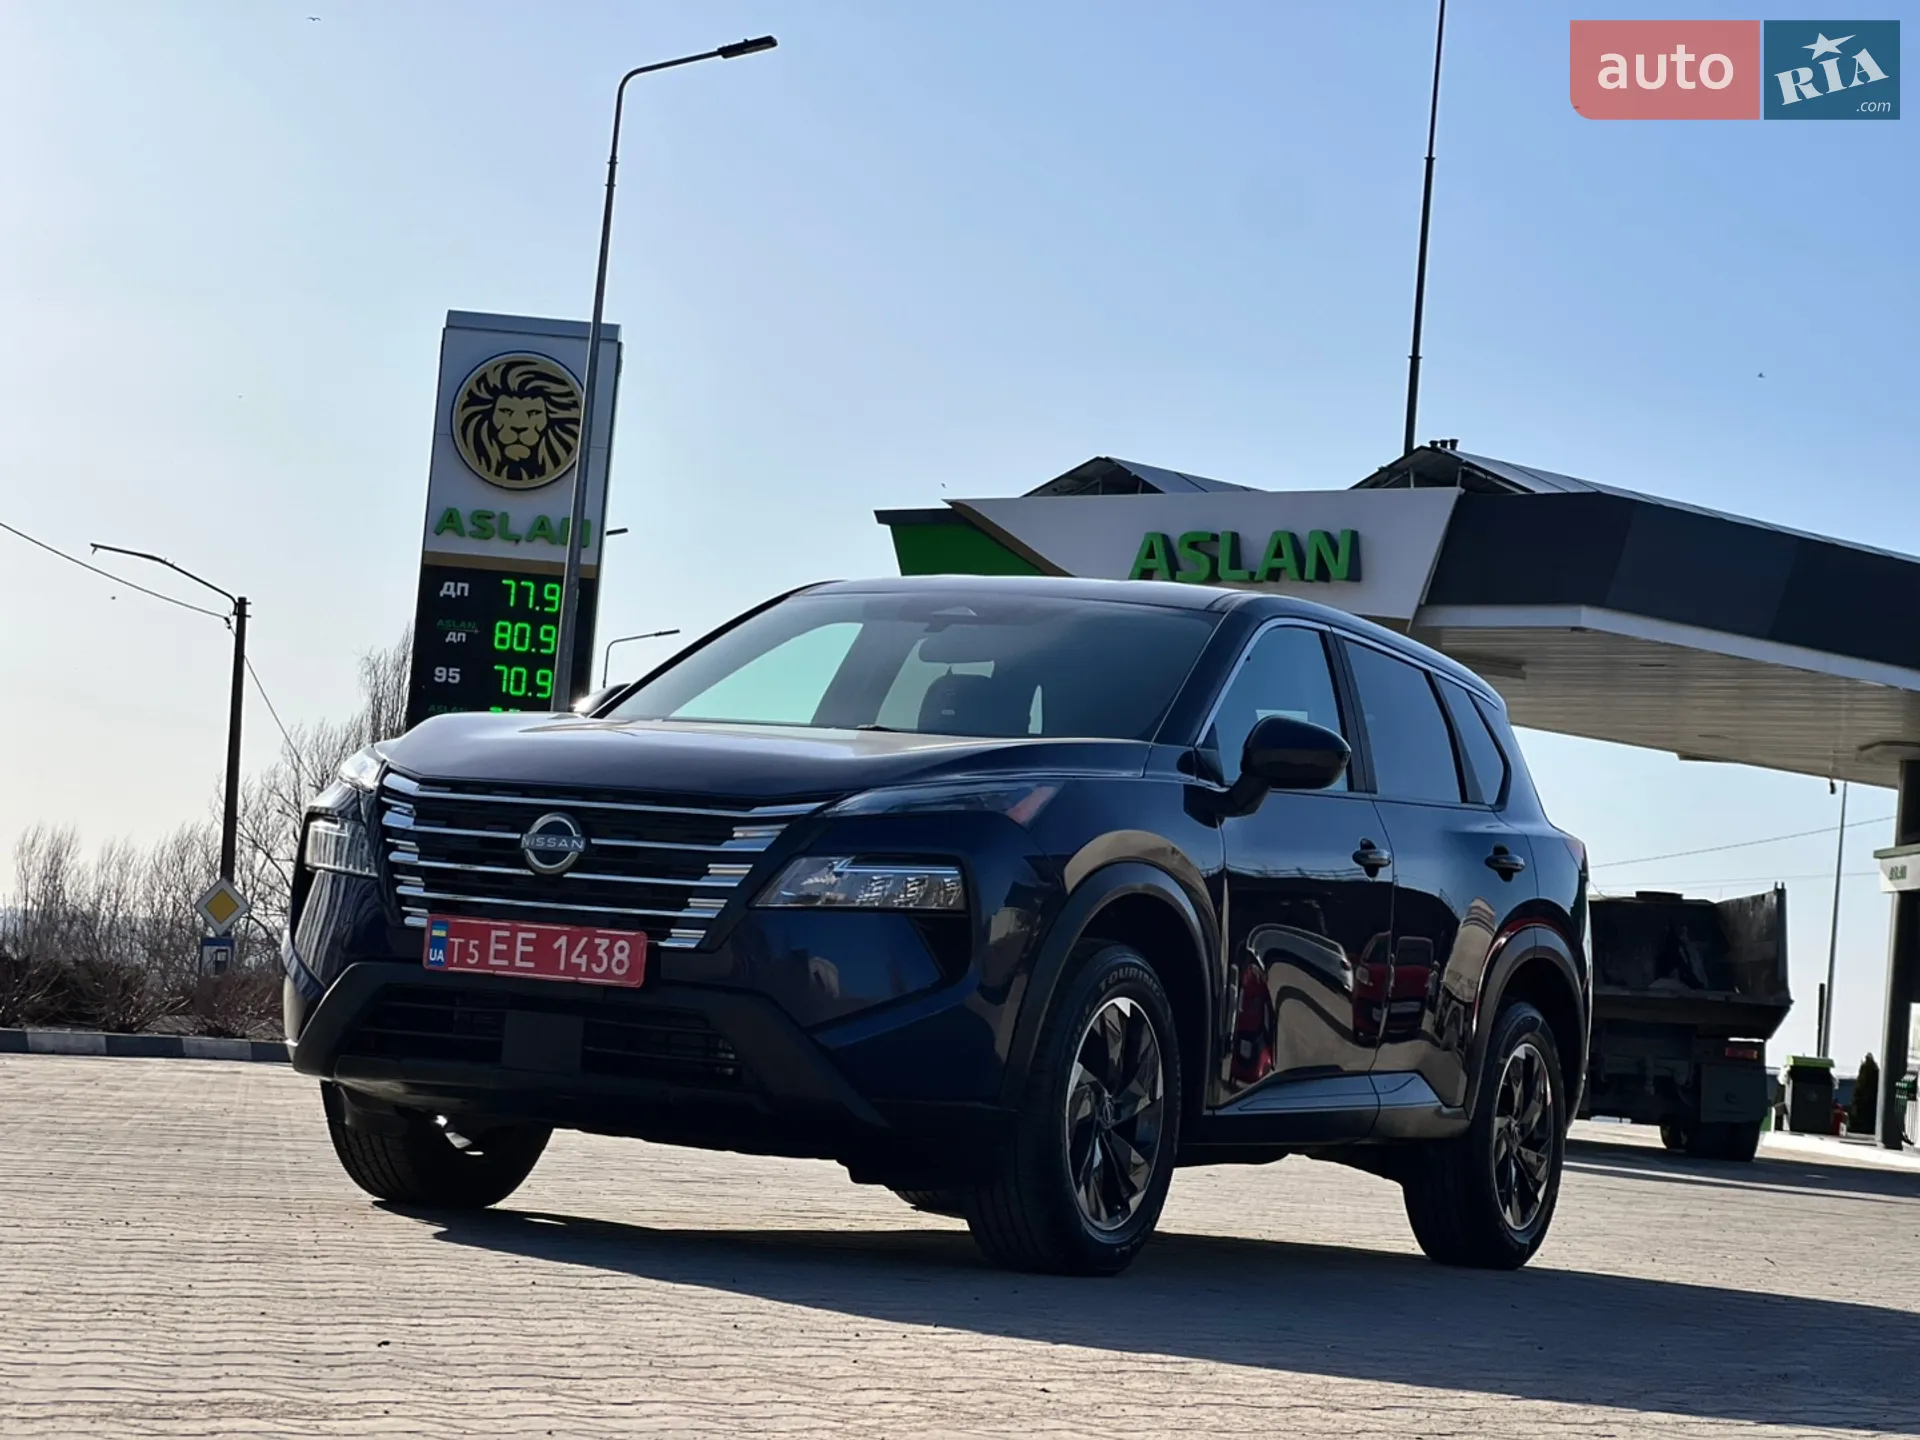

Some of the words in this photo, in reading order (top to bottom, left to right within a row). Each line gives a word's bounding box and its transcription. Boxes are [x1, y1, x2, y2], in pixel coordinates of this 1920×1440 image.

[1128, 528, 1362, 583] ASLAN
[439, 581, 470, 598] ДП
[501, 579, 561, 612] 77.9
[494, 620, 557, 654] 80.9
[433, 666, 461, 684] 95
[493, 665, 553, 698] 70.9
[521, 836, 585, 850] NISSAN
[428, 948, 445, 963] UA
[487, 929, 536, 968] EE
[552, 934, 631, 976] 1438
